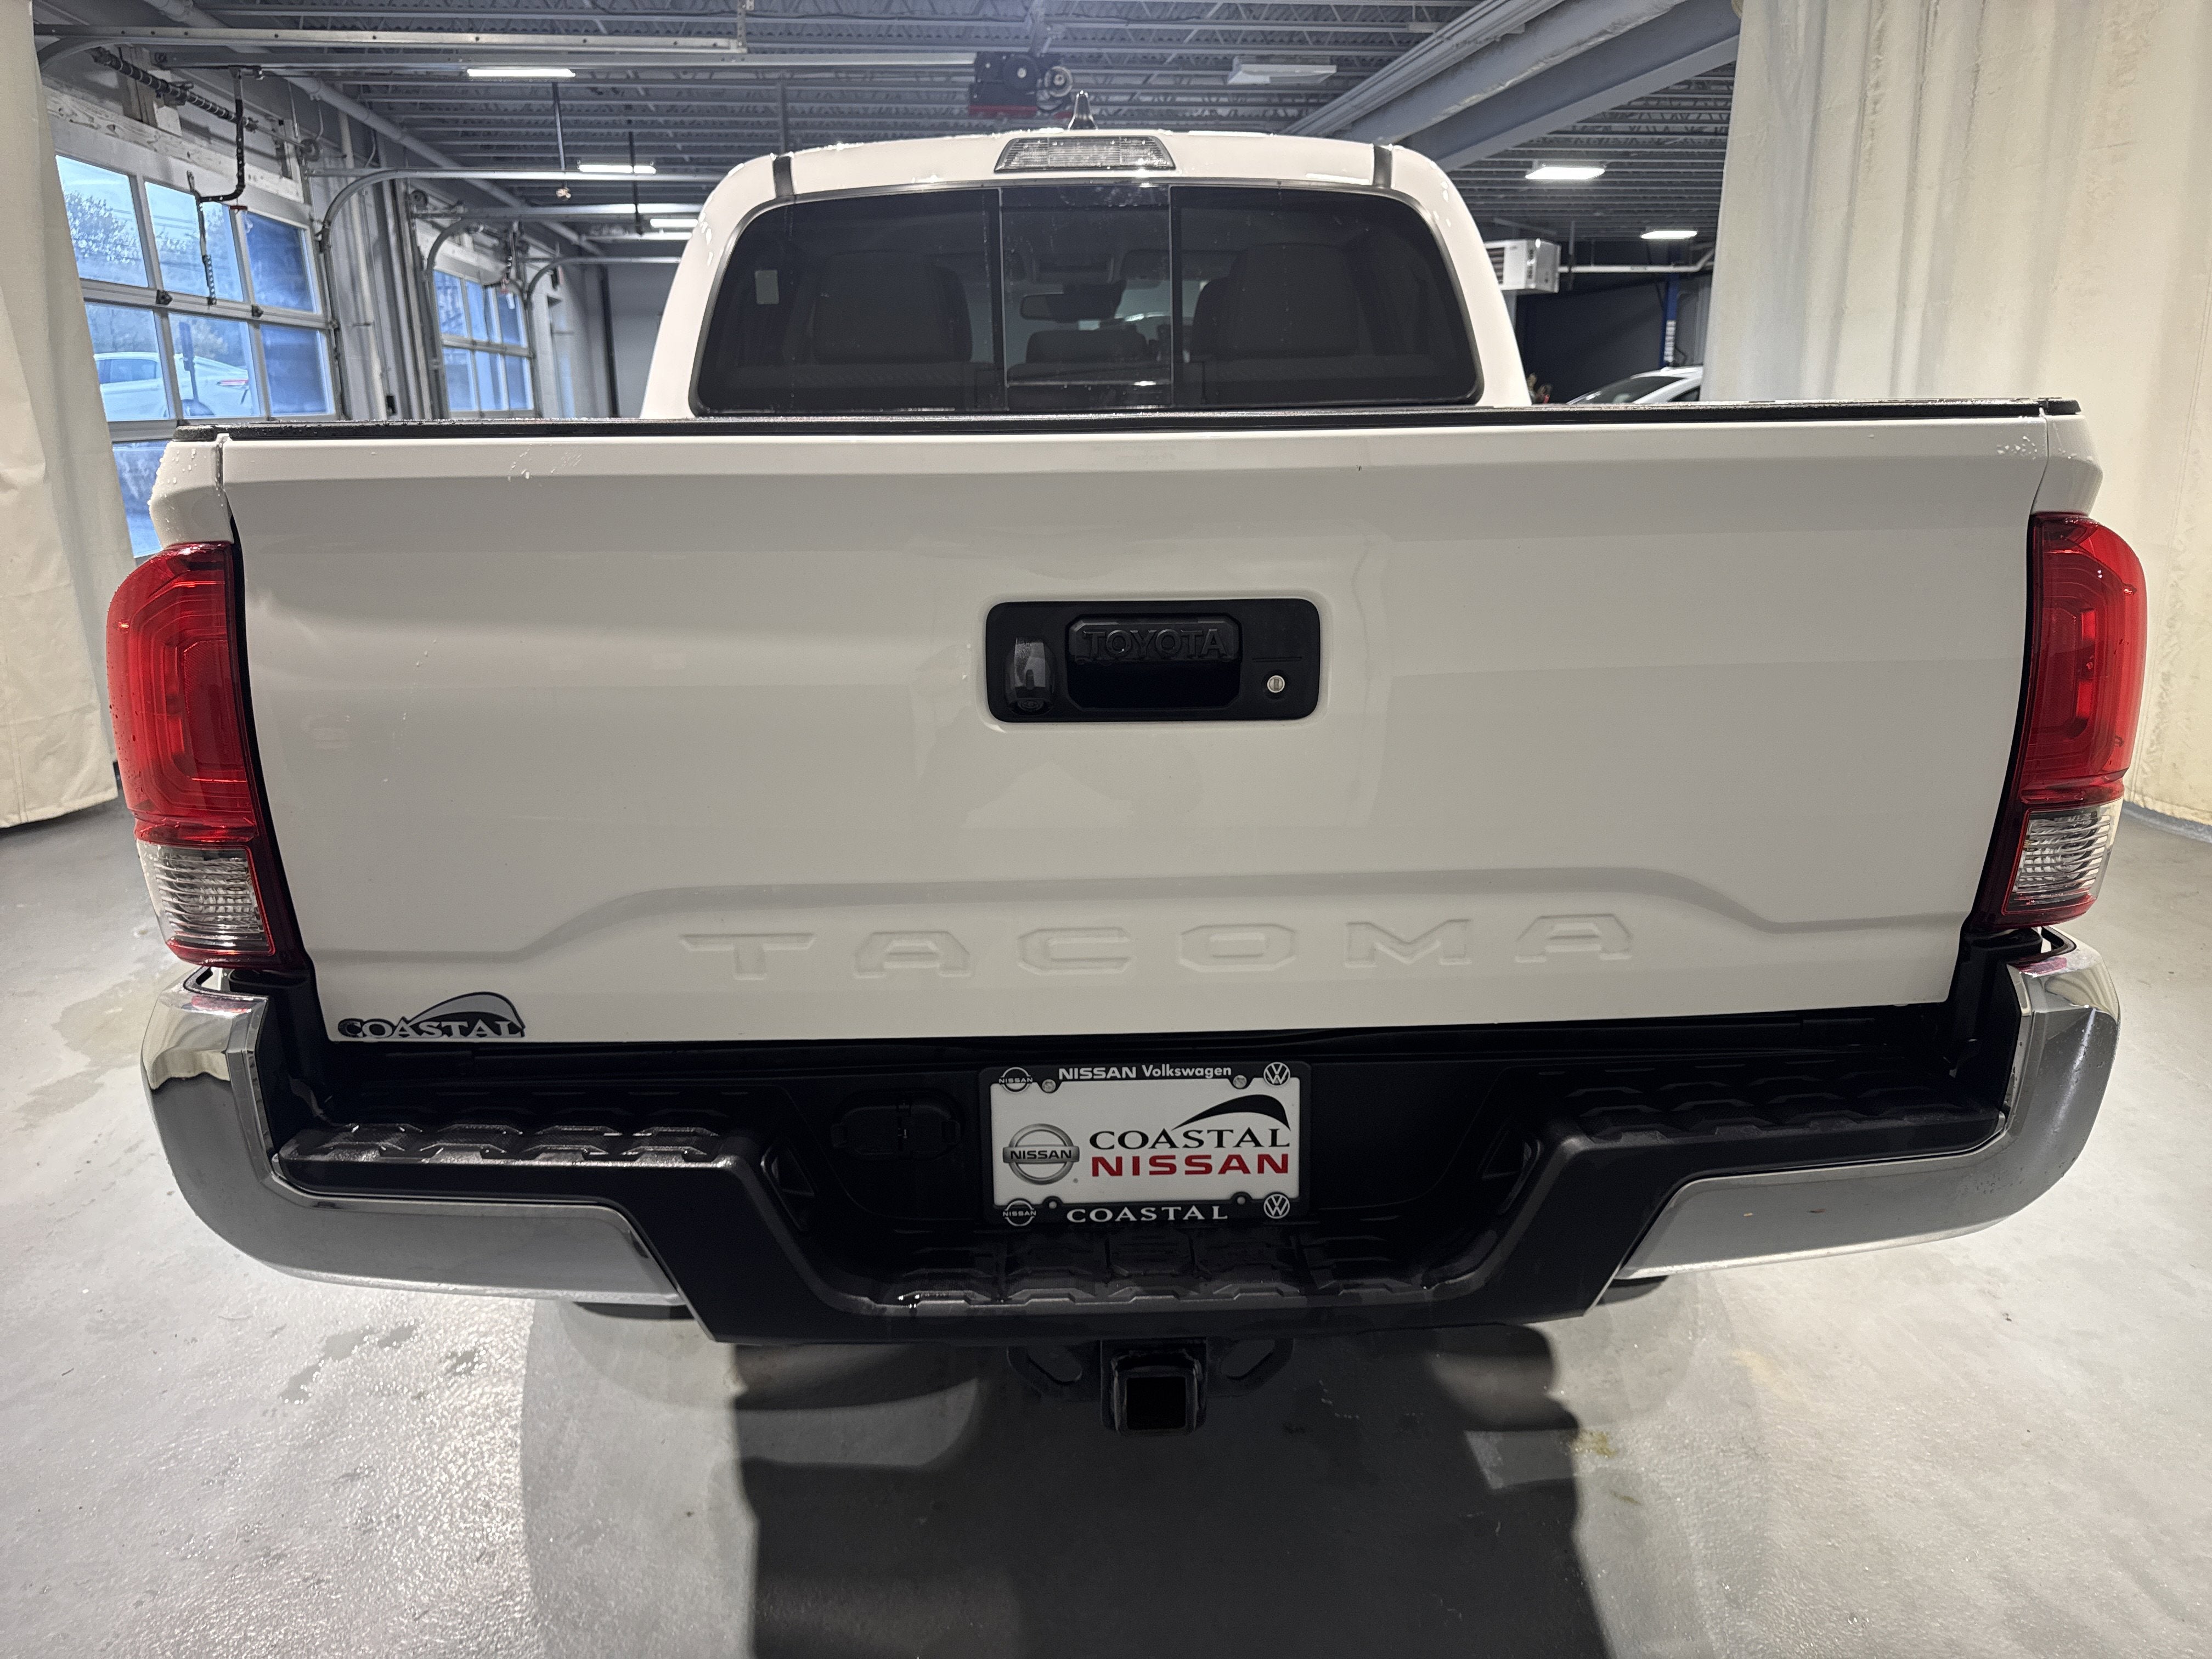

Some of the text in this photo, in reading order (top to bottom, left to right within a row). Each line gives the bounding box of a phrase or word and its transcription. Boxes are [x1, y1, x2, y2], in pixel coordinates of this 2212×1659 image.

[1084, 629, 1227, 657] TOYOTA
[680, 913, 1633, 980] TACOMA
[338, 1018, 525, 1038] COASTAL
[1059, 1064, 1232, 1080] NISSAN Volkswagen
[1089, 1127, 1290, 1150] COASTAL
[1010, 1149, 1072, 1160] NISSAN
[1092, 1154, 1288, 1176] NISSAN
[1066, 1205, 1228, 1223] COASTAL
